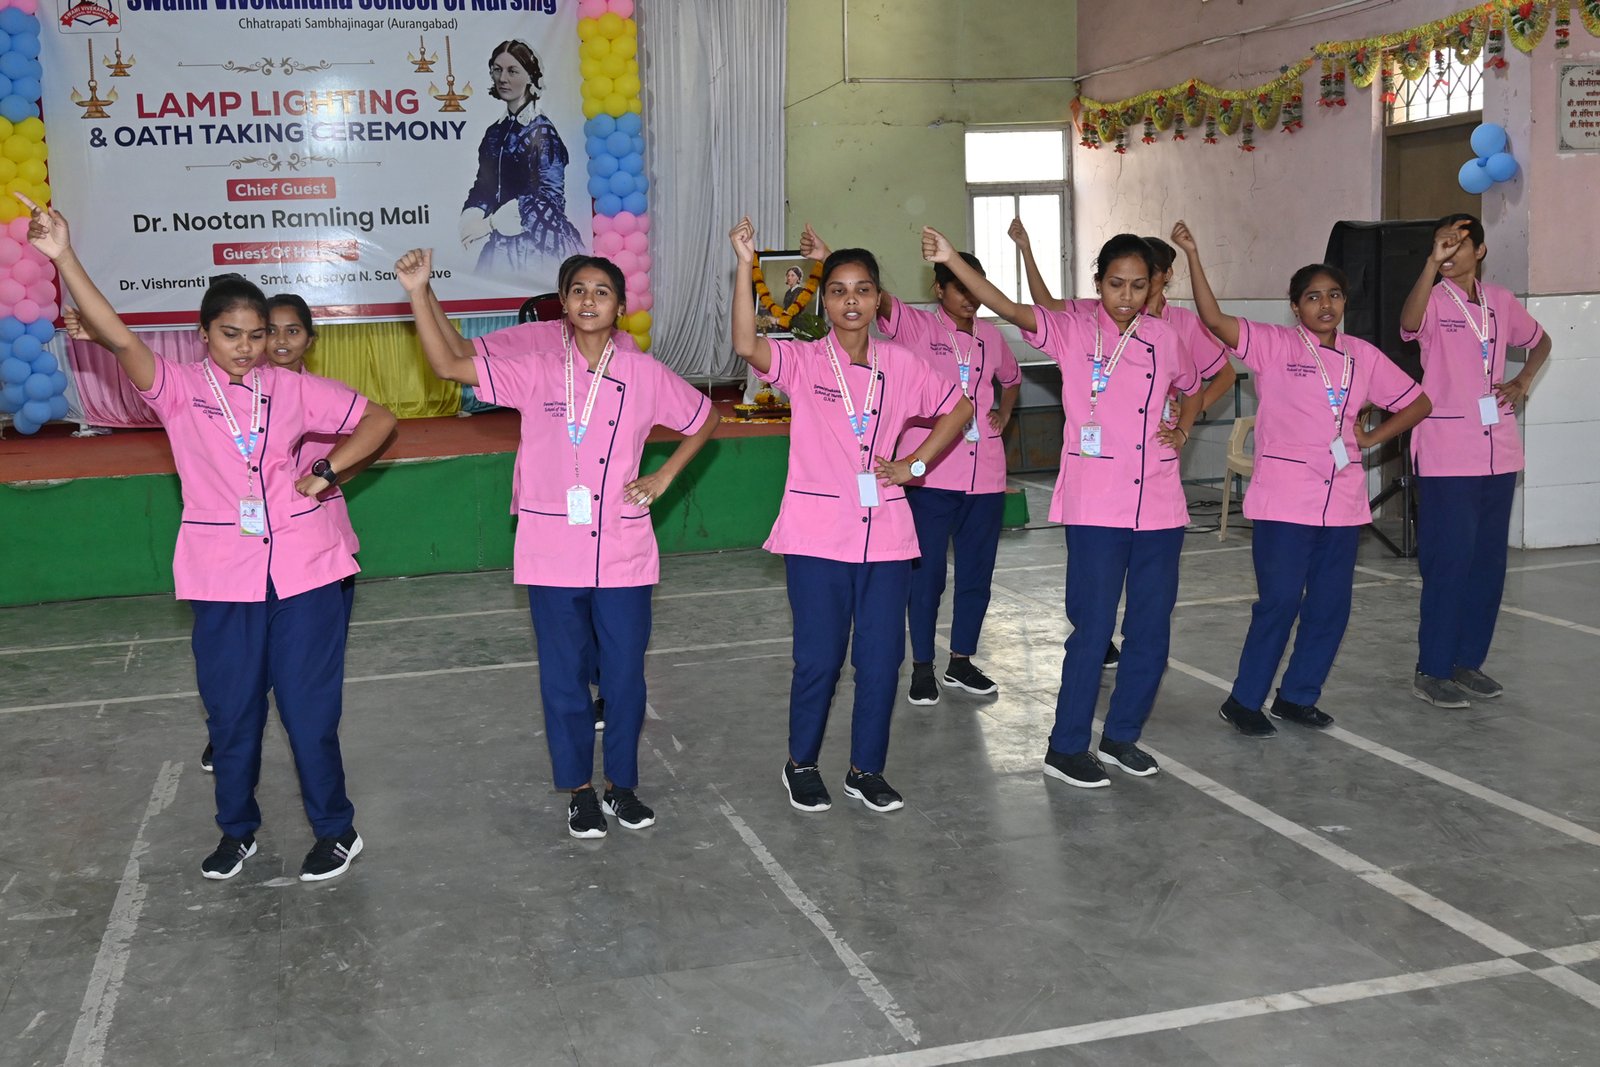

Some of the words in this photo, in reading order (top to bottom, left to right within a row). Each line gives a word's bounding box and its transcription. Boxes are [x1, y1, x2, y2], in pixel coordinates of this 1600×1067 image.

[238, 18, 302, 32] Chhatrapati
[305, 17, 385, 32] Sambhajinagar
[387, 17, 459, 31] (Aurangabad)
[136, 91, 242, 119] LAMP
[251, 88, 421, 117] LIGHTING
[89, 127, 108, 149] &
[114, 125, 193, 147] OATH
[199, 122, 304, 145] TAKING
[311, 120, 467, 143] CEREMONY
[235, 183, 278, 197] Chief
[281, 182, 328, 196] Guest
[133, 214, 168, 233] Dr.
[173, 211, 266, 231] Nootan
[271, 206, 375, 232] Ramling
[380, 204, 430, 225] Mali
[223, 248, 269, 261] Guest
[271, 246, 289, 259] Of
[119, 280, 139, 291] Dr.
[141, 276, 206, 291] Vishranti
[260, 273, 291, 285] Smt.
[359, 271, 373, 281] N.
